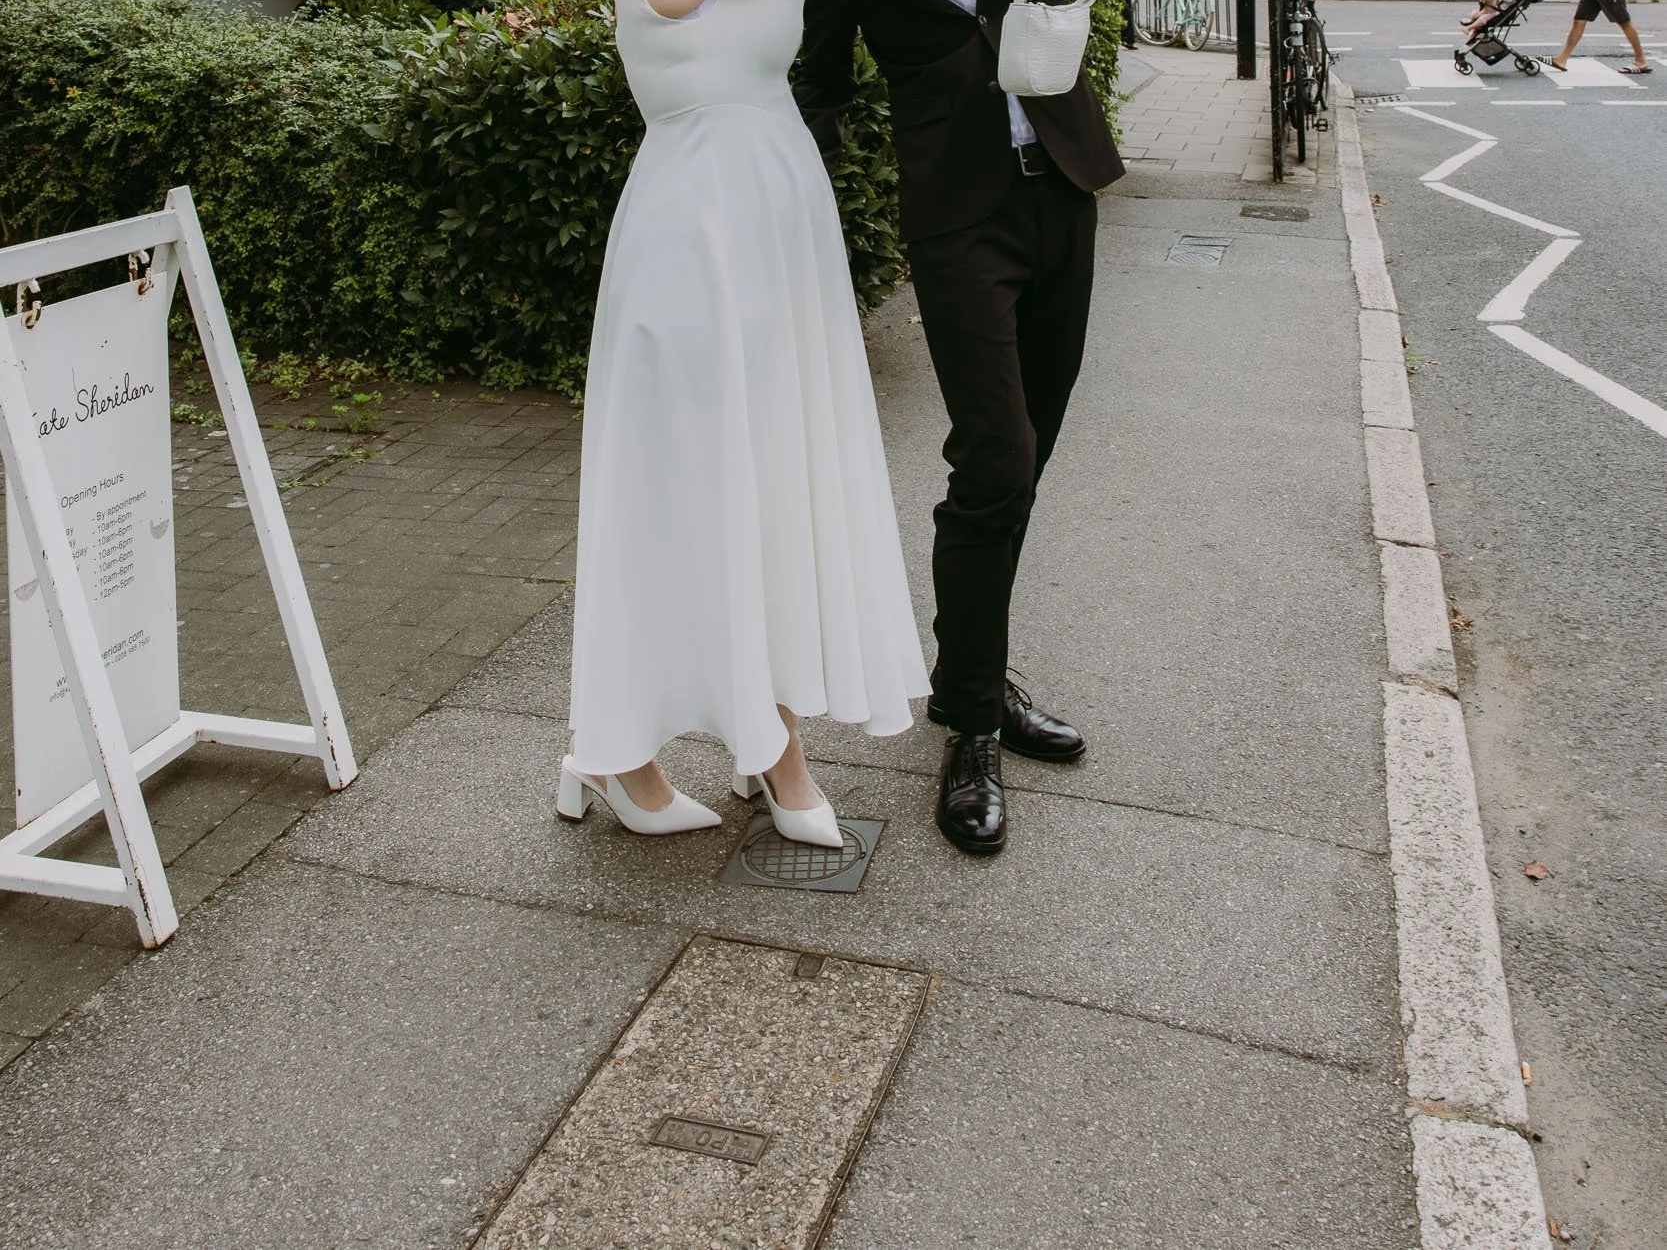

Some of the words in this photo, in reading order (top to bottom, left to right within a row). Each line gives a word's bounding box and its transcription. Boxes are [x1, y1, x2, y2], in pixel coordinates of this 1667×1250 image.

[32, 407, 69, 438] ate
[75, 372, 155, 422] Sheridan
[61, 486, 97, 508] Opening
[100, 473, 124, 490] Hours
[96, 511, 105, 521] By
[107, 490, 147, 516] appointment
[98, 511, 133, 533] 10am-6pm
[98, 524, 133, 546] 10am-6pm
[99, 537, 133, 559] 10am-6pm
[99, 550, 133, 572] 10am-6pm
[100, 563, 134, 585] 10am-6pm
[100, 576, 135, 598] 12pm-5pm
